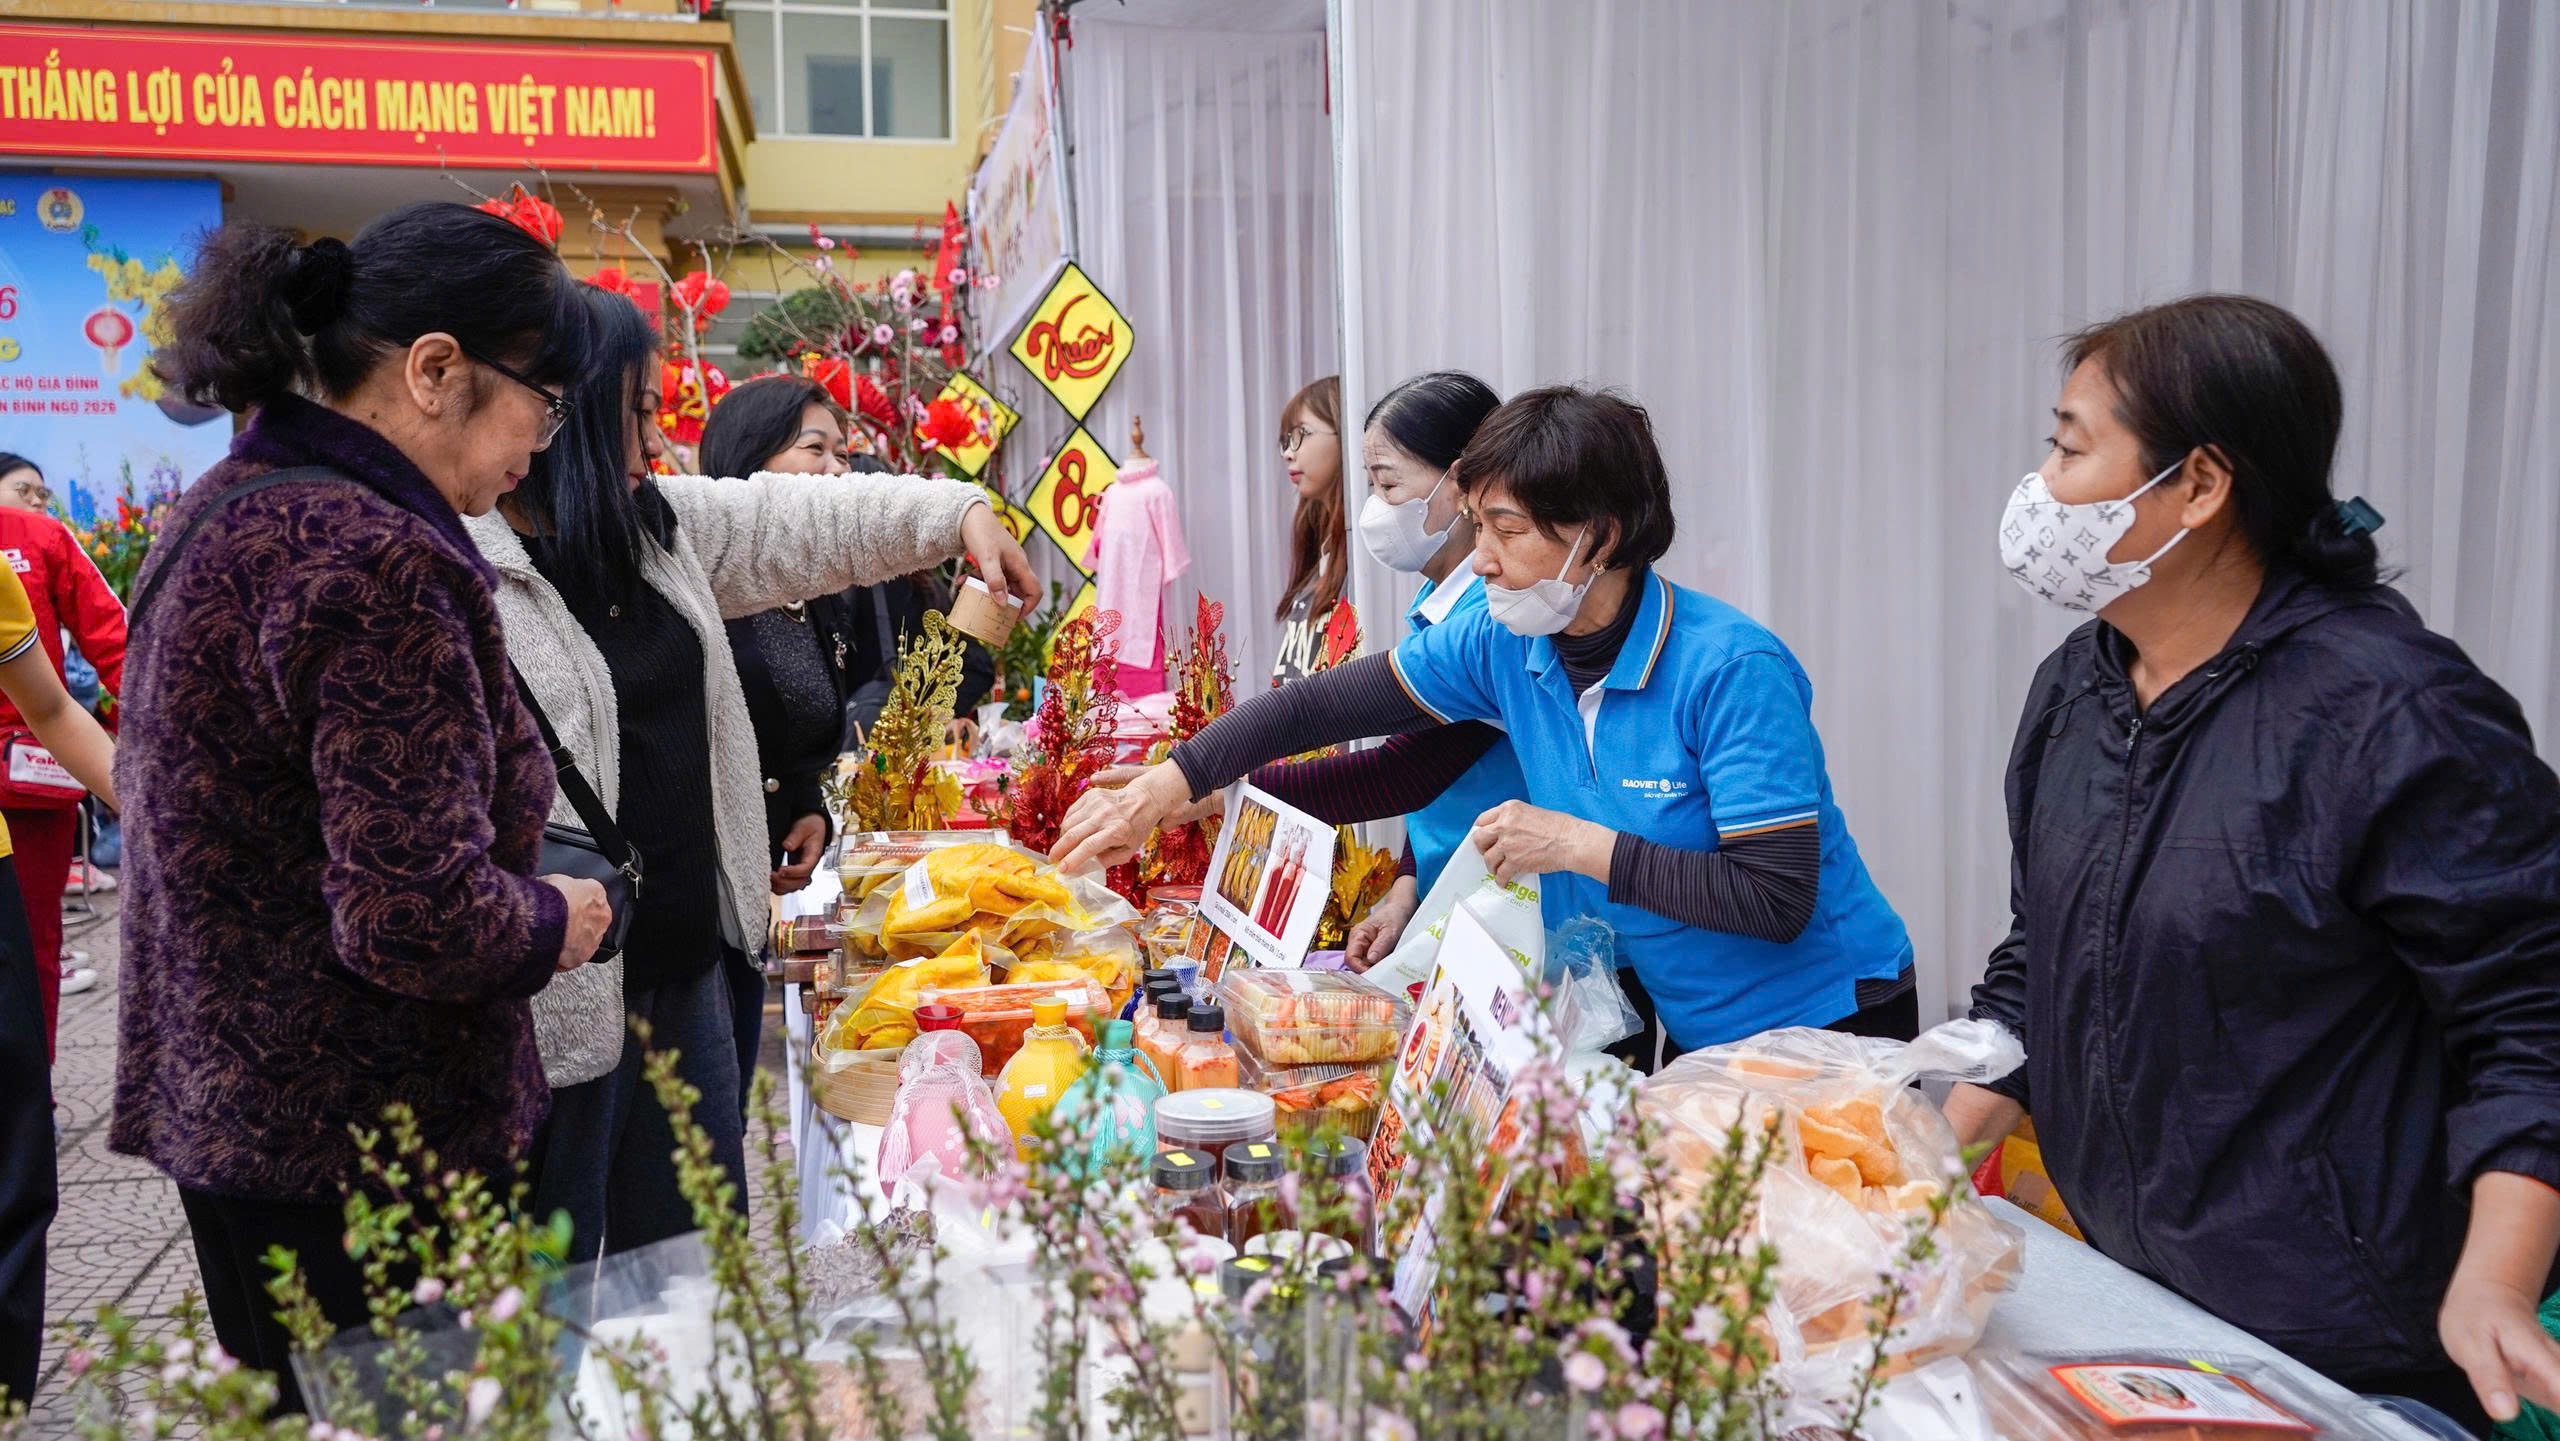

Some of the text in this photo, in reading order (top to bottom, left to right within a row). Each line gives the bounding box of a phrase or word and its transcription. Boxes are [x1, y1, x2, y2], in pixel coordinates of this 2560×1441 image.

[0, 48, 656, 147] THẮNG LỢI CỦA CÁCH MẠNG VIỆT NAM!
[38, 376, 61, 390] GIA
[83, 400, 117, 415] 2026
[1622, 779, 1687, 789] BAOVIET Life
